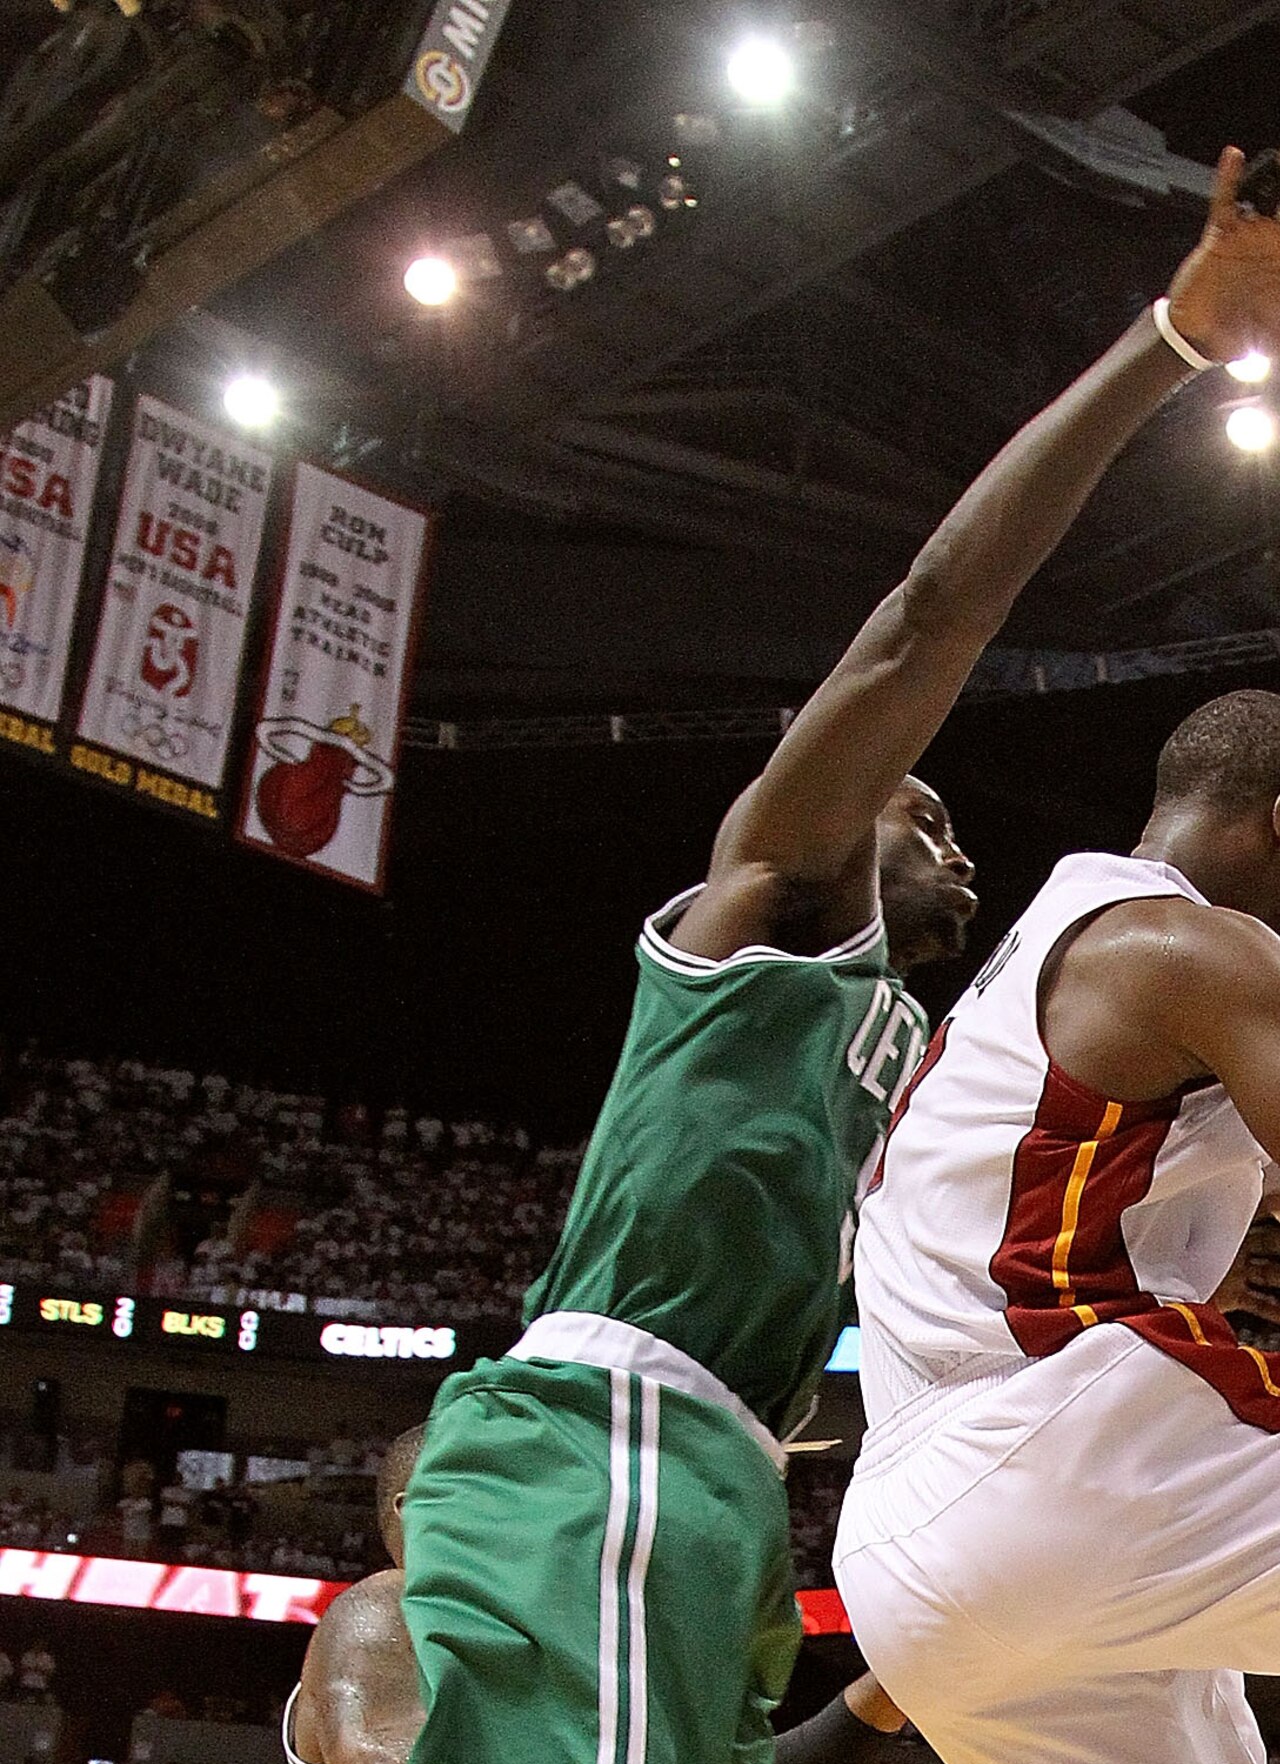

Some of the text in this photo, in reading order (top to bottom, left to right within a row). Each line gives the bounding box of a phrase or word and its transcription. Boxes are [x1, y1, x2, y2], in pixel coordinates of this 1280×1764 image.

[1, 452, 74, 519] SA
[136, 511, 238, 589] USA
[40, 1298, 103, 1326] STLS
[162, 1310, 226, 1338] BLKS
[320, 1323, 455, 1359] CELTICS
